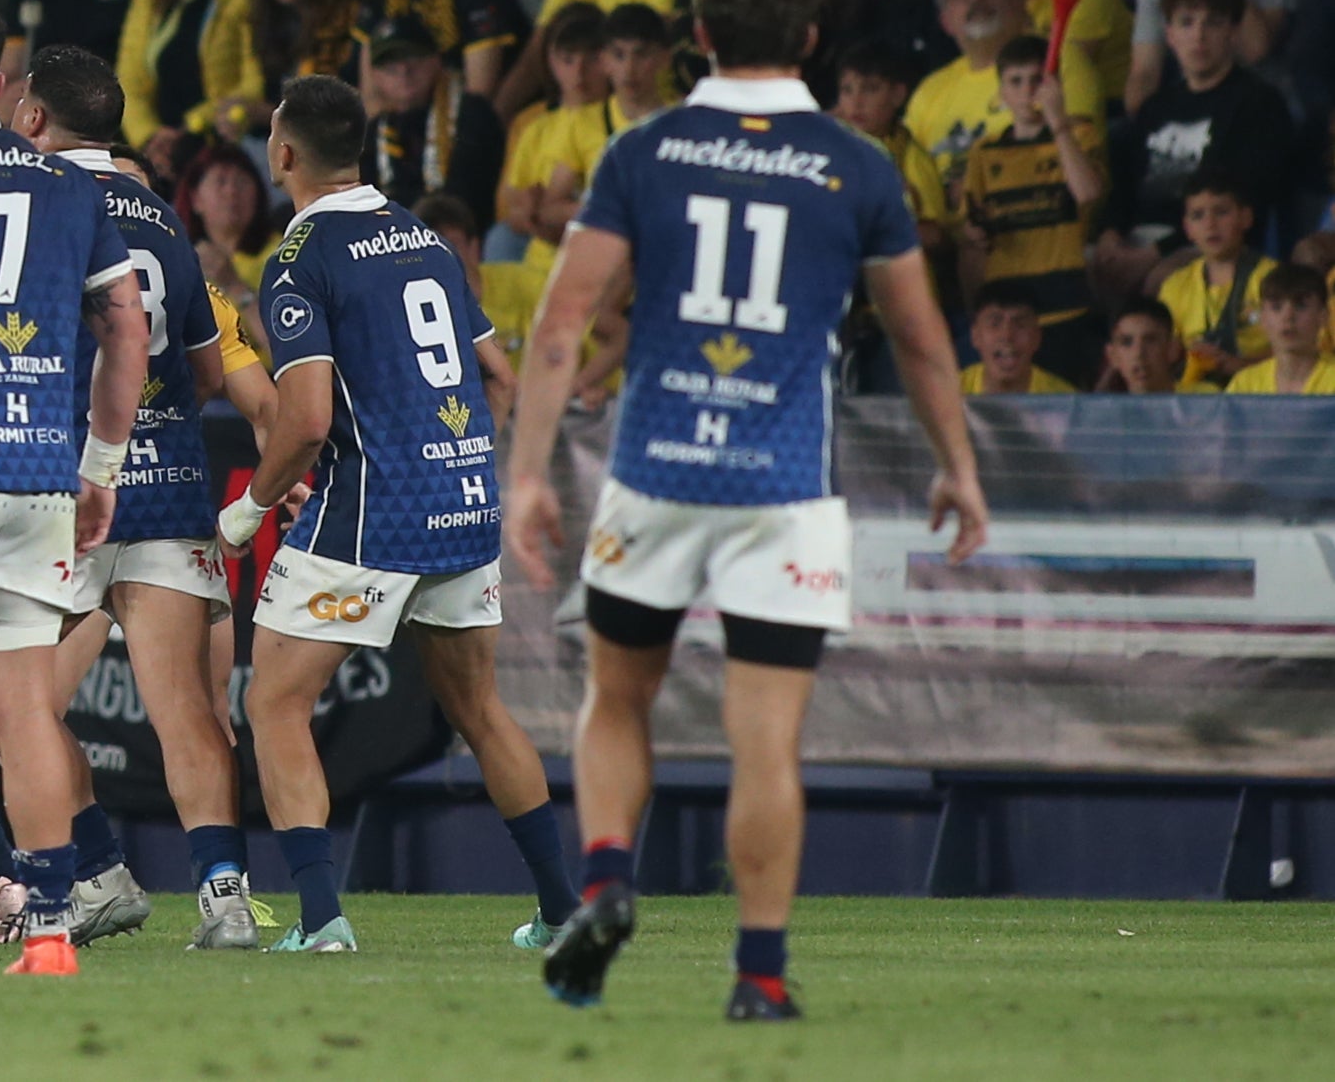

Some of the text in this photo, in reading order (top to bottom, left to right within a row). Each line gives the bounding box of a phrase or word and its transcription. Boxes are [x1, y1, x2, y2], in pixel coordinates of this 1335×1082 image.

[656, 135, 832, 188] meléndez
[347, 225, 453, 261] meléndez
[678, 193, 790, 335] 11
[402, 278, 463, 389] 9
[10, 356, 65, 374] RURAL
[422, 441, 456, 460] CAJA
[308, 587, 385, 623] GO fit
